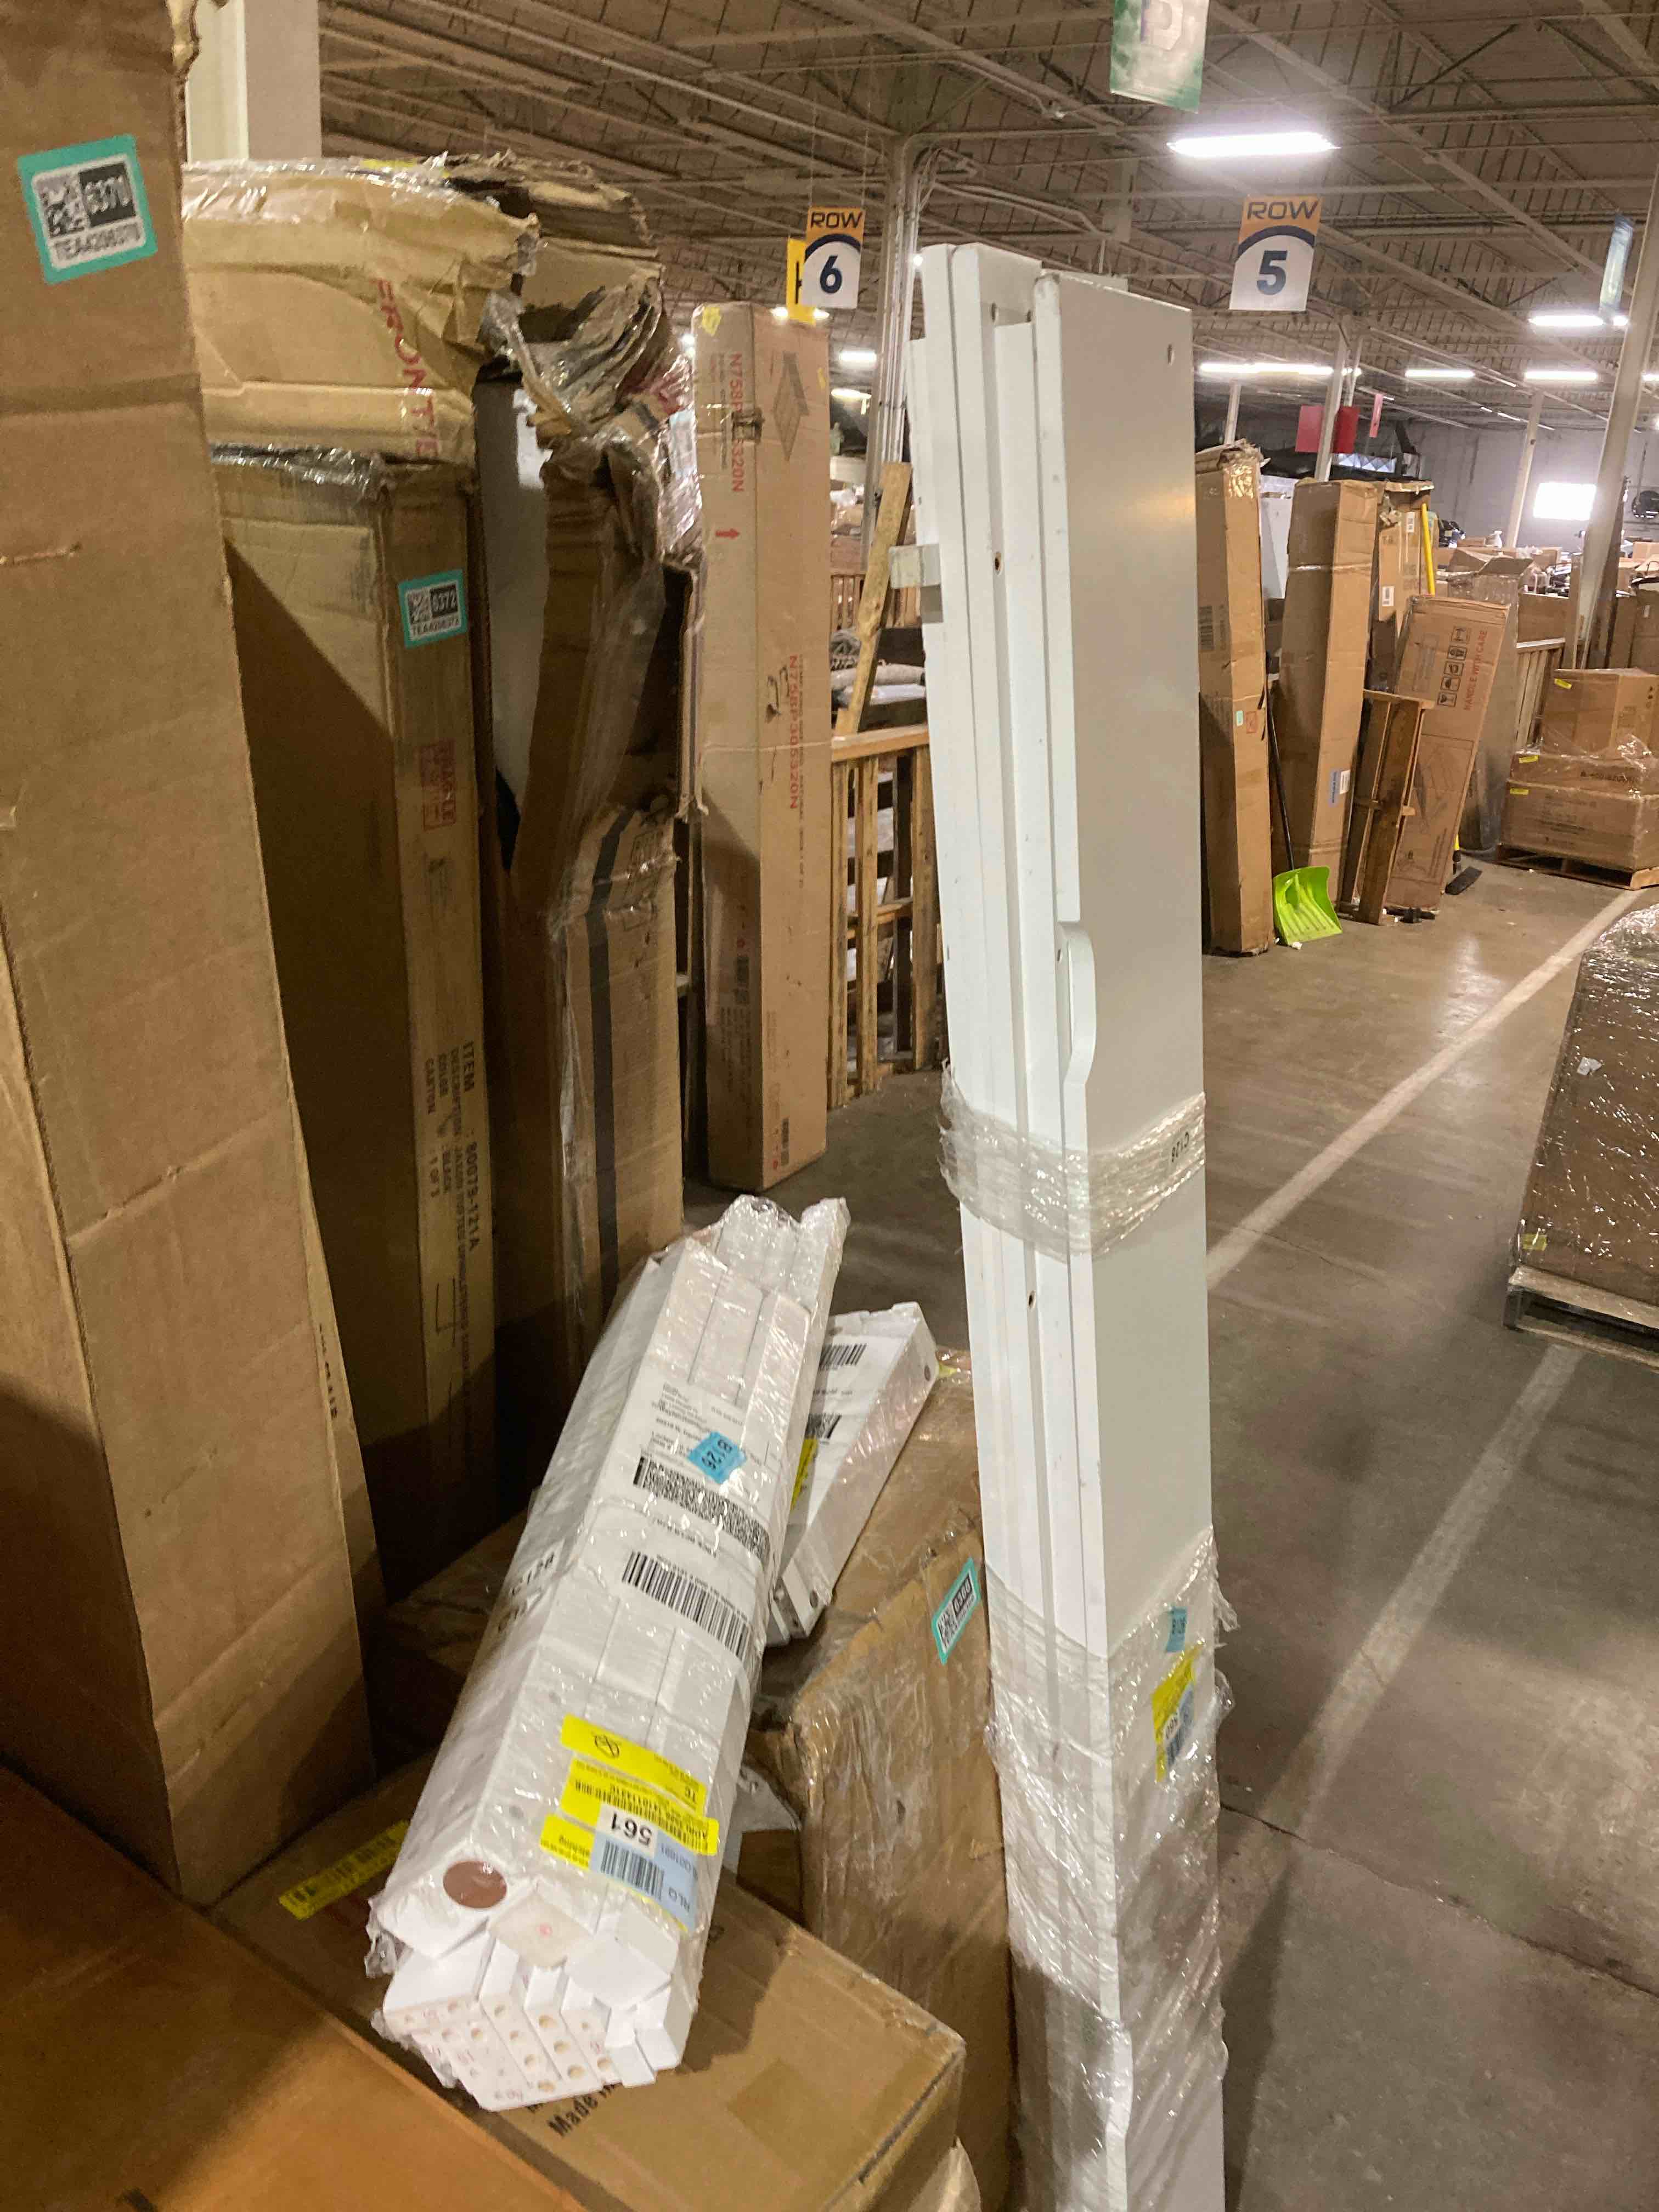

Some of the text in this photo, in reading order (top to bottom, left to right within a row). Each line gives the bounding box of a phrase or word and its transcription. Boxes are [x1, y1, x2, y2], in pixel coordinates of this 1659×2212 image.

[810, 211, 862, 229] ROW
[1246, 201, 1319, 220] ROW
[820, 255, 843, 294] 6
[1256, 250, 1289, 295] 5
[1463, 630, 1488, 711] HANDLE WITH CARE
[462, 1041, 475, 1092] ITEM
[610, 1812, 653, 1847] 561
[547, 2093, 599, 2138] Made
